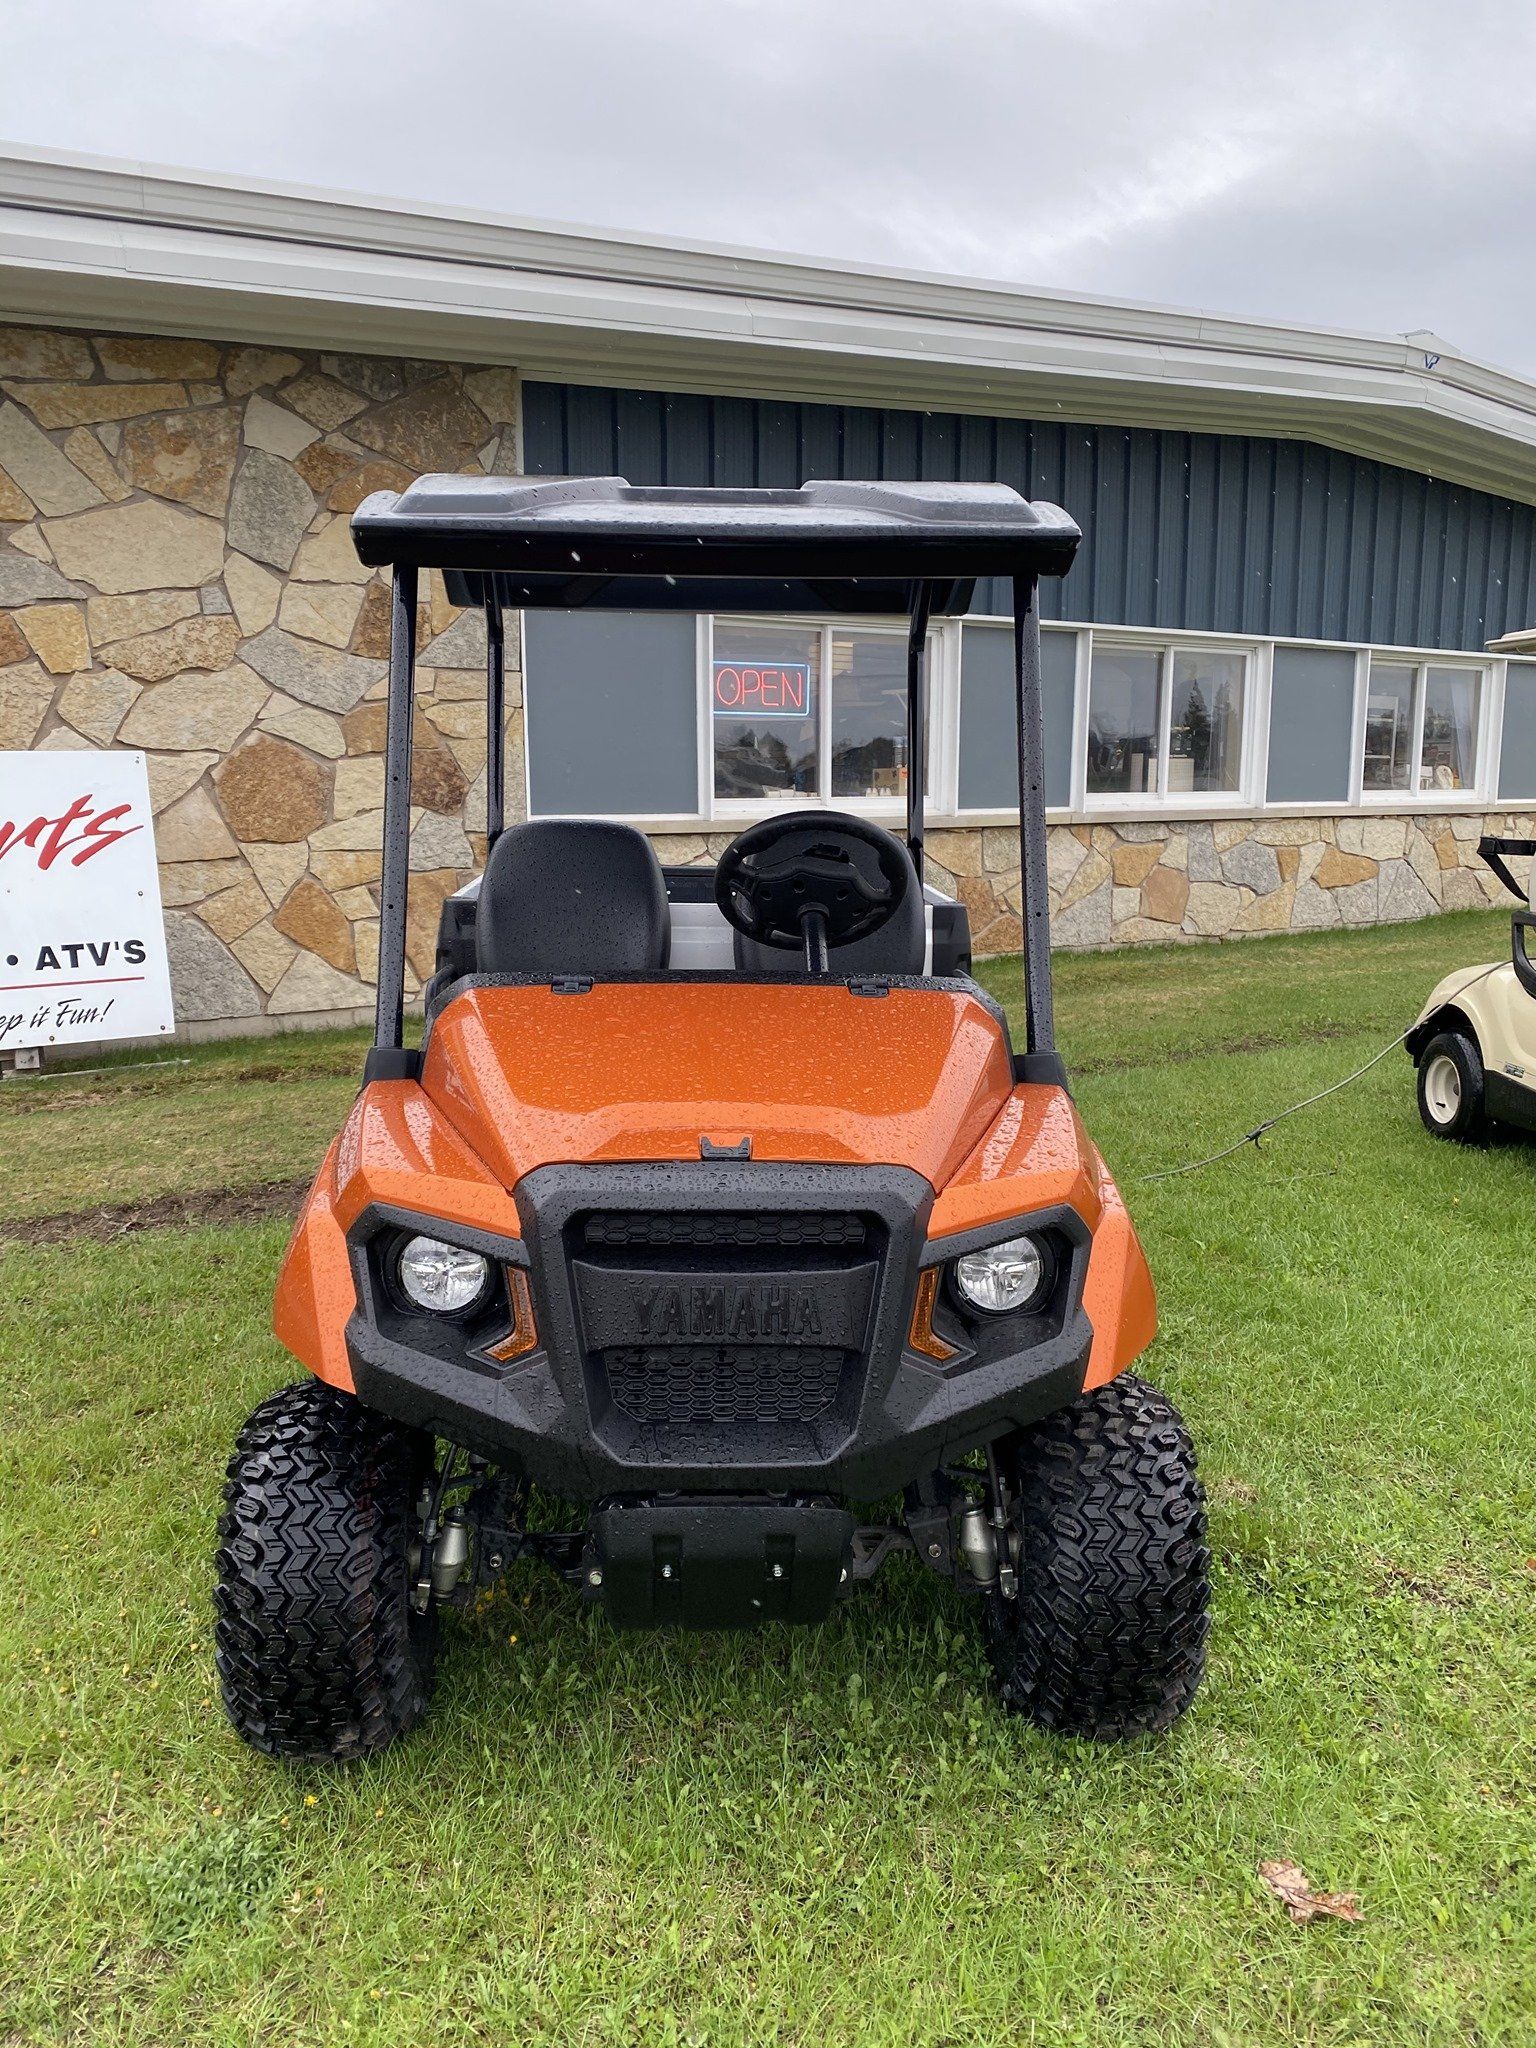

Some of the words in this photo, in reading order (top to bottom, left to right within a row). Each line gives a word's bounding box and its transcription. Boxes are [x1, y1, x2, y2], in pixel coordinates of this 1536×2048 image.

[716, 667, 802, 708] OPEN
[35, 939, 147, 971] ATV'S
[29, 1004, 51, 1029] it
[55, 998, 115, 1028] Fun!
[629, 1285, 823, 1336] YAMAHA
